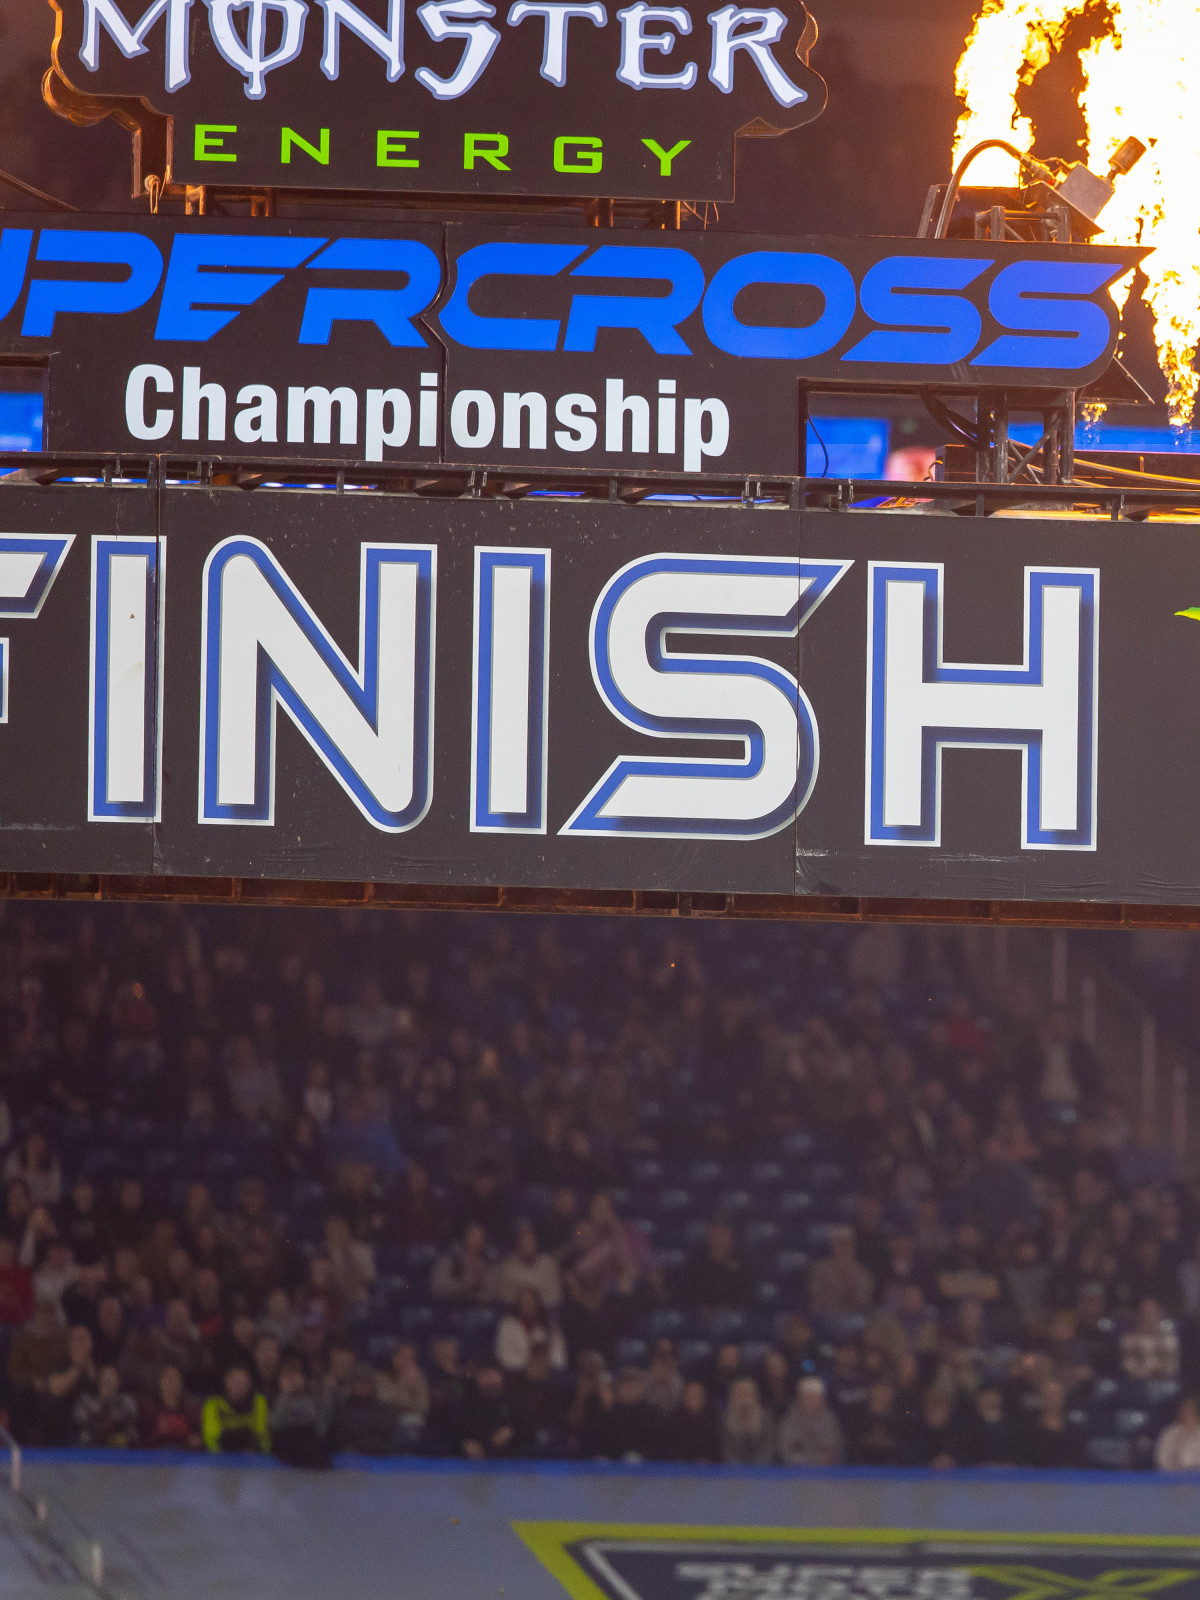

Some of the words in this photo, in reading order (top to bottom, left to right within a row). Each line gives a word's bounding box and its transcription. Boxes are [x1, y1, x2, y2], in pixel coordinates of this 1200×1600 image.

[77, 0, 810, 108] MONSTER
[193, 123, 693, 177] ENERGY
[125, 363, 730, 472] Championship
